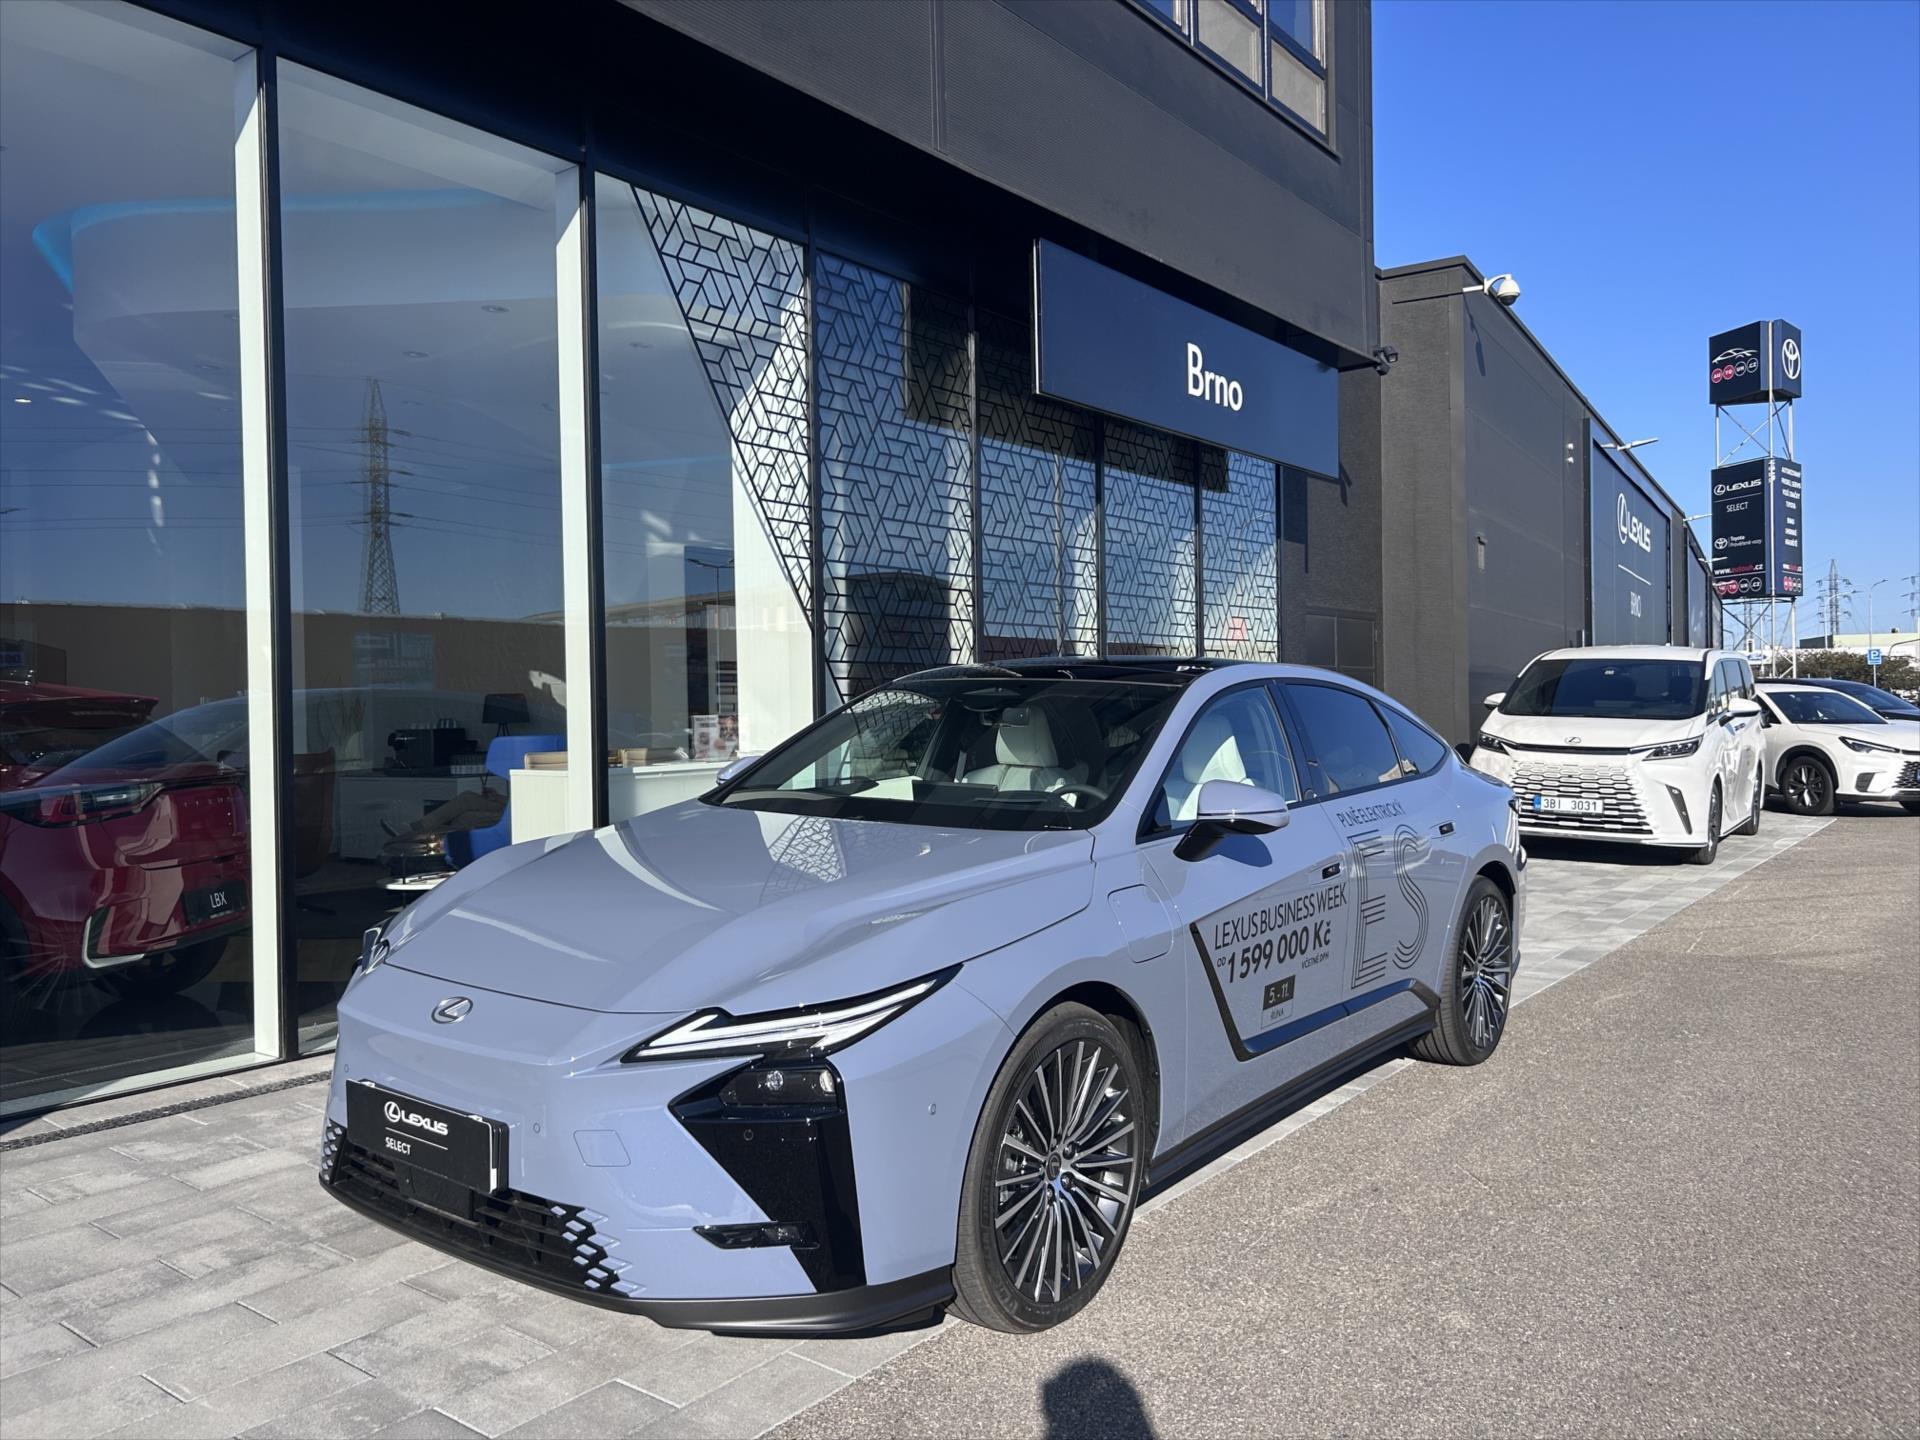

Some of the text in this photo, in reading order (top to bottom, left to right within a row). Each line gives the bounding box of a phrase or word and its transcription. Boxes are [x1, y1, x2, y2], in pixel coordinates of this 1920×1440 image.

[1187, 342, 1243, 411] Brno
[1726, 479, 1762, 492] LEXUS
[1726, 501, 1749, 513] SELECT
[1627, 511, 1651, 553] LEXUS
[1571, 800, 1597, 811] 3031
[209, 891, 227, 909] LBX
[1347, 824, 1429, 990] ES
[1214, 882, 1347, 950] LEXUS BUSINESS WEEK
[1216, 956, 1227, 968] OD
[1312, 920, 1331, 951] Kč
[401, 1110, 449, 1136] LEXUS
[385, 1137, 411, 1155] SELECT
